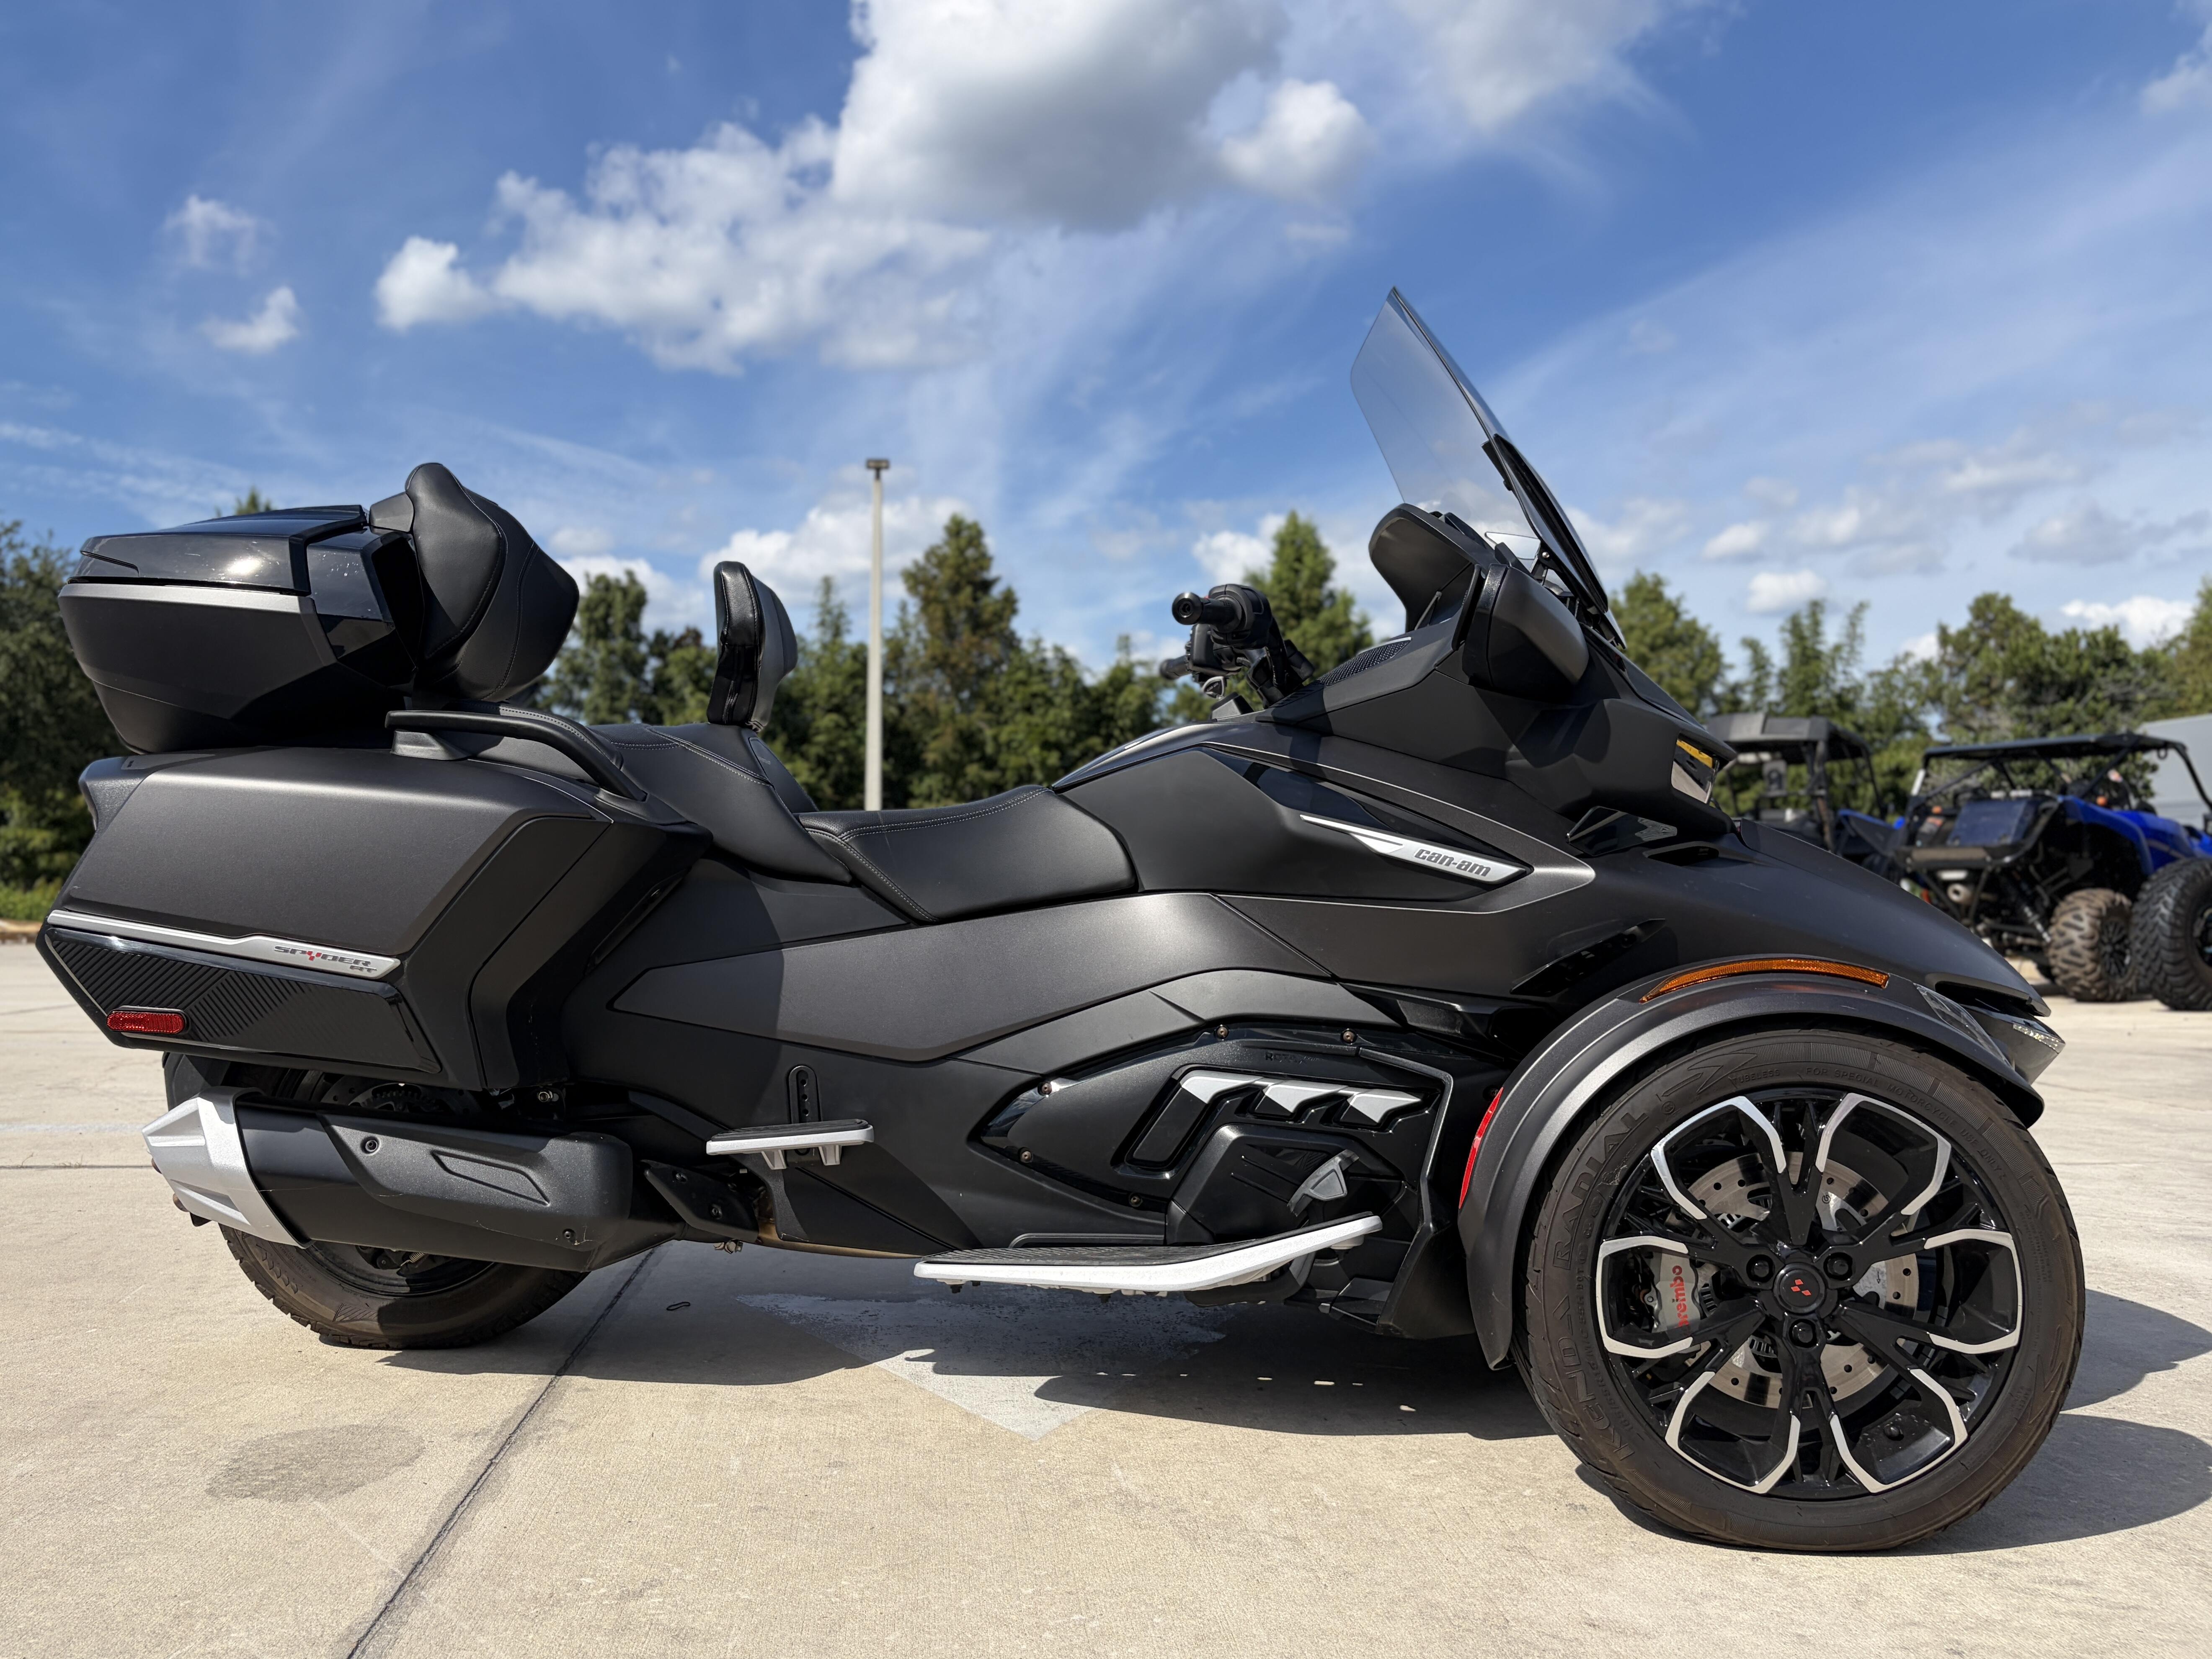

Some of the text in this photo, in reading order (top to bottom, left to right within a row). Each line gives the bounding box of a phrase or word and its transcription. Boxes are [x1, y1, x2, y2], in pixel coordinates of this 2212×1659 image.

[1415, 849, 1491, 877] can-am
[274, 946, 372, 966] SPYDER
[1732, 1068, 1780, 1086] TUBELESS
[1806, 1067, 2001, 1174] FOR SPECIAL MOTORCYCLE USE ONLY
[1552, 1113, 1649, 1460] KENDA RADIAL
